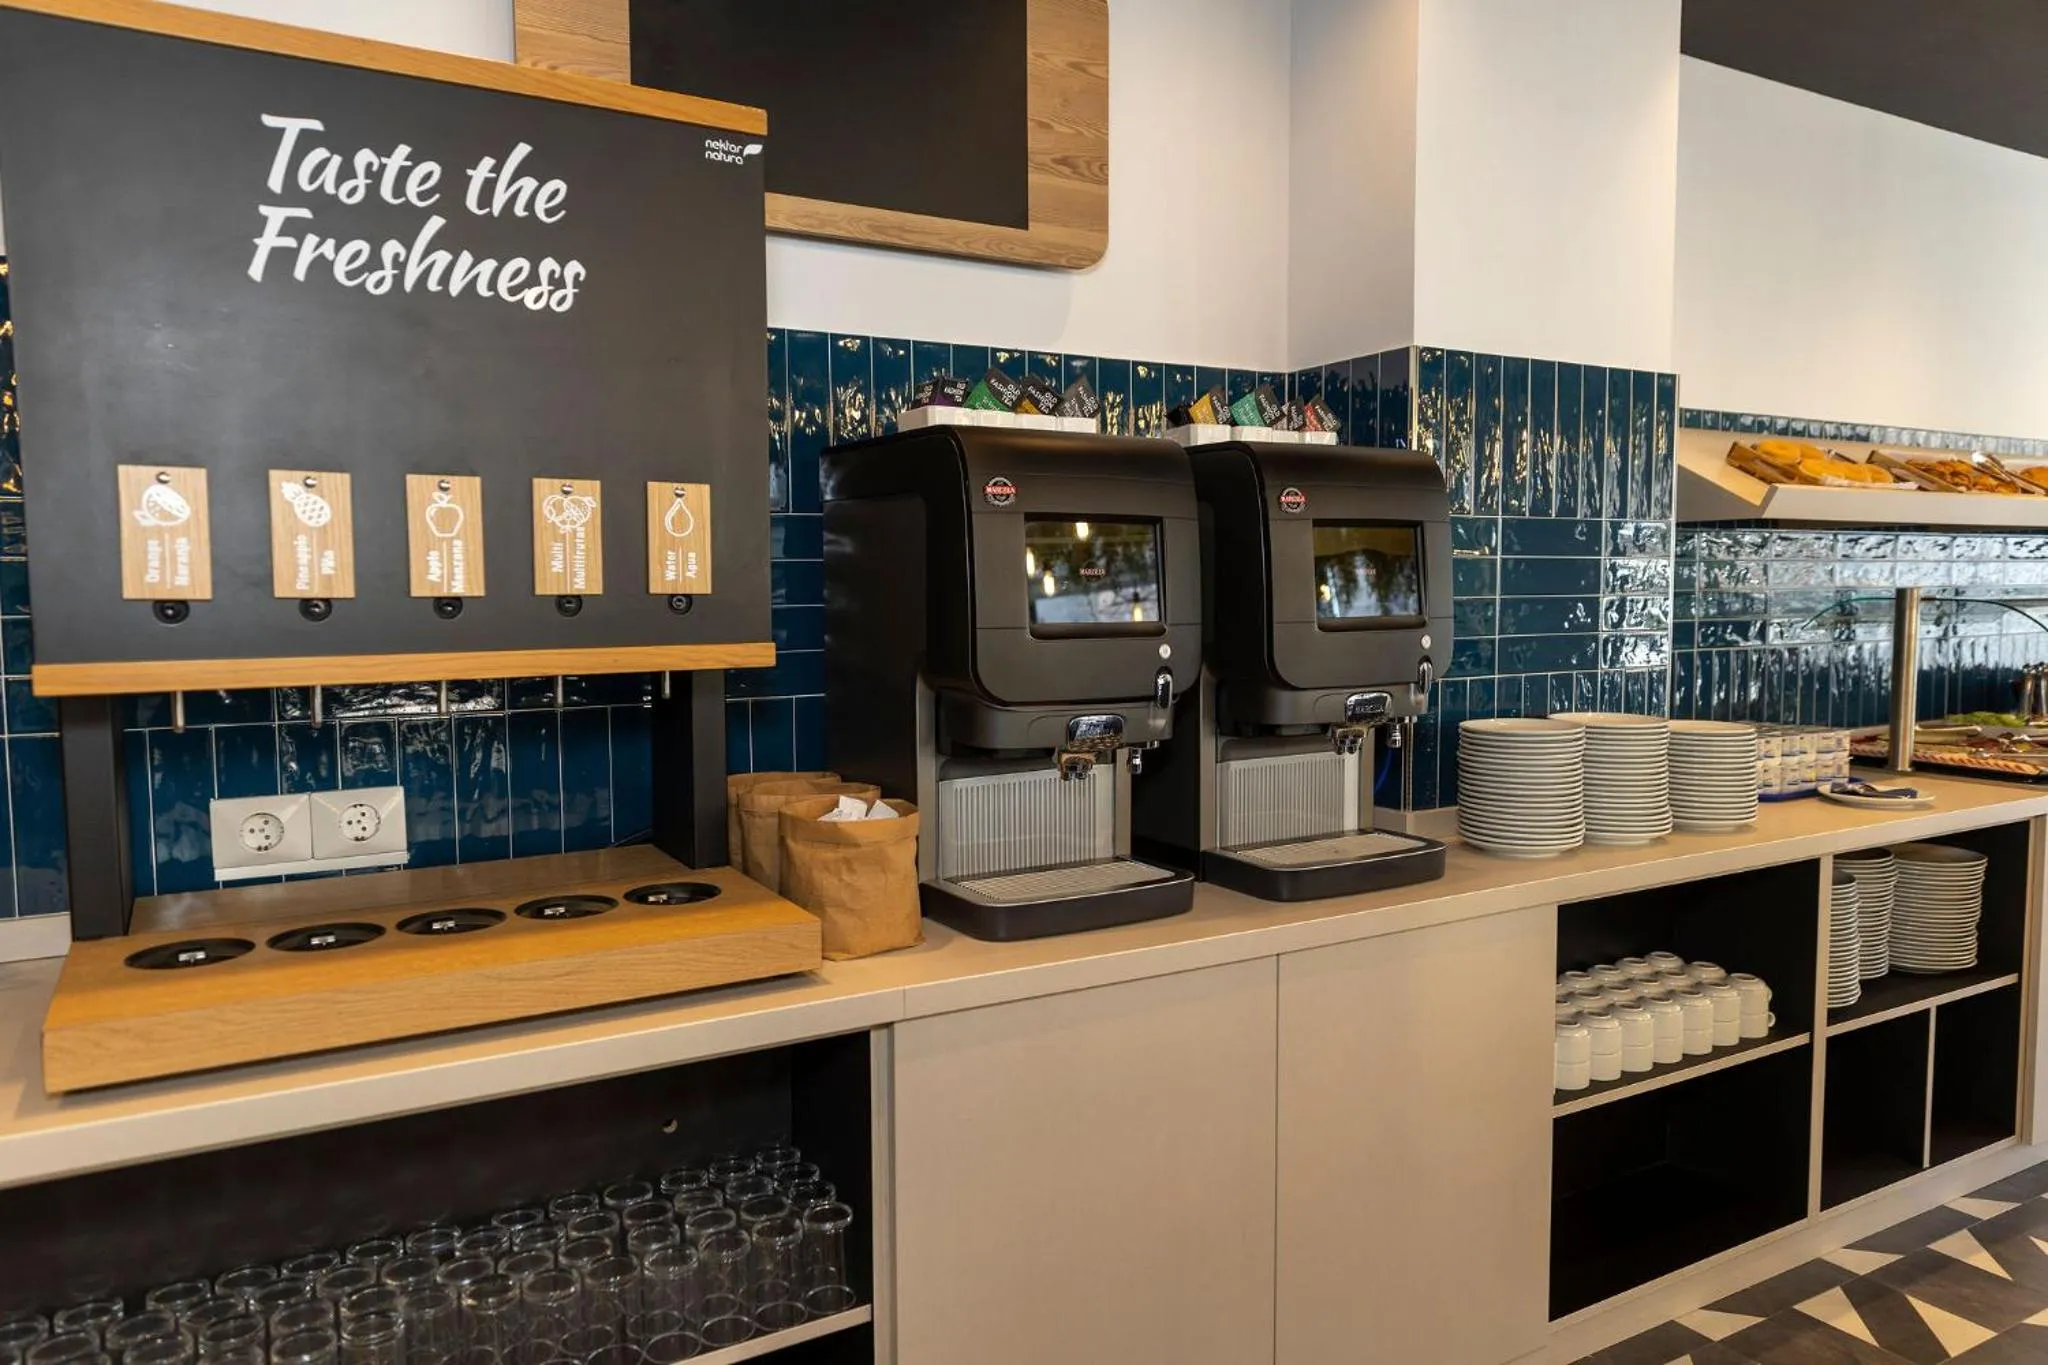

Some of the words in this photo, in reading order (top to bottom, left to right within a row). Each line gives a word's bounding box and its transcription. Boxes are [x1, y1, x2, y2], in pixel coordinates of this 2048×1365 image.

[705, 139, 743, 153] nektar
[705, 150, 744, 165] natura
[261, 113, 442, 207] Taste
[465, 142, 568, 223] the
[247, 204, 586, 313] Freshness
[1007, 384, 1021, 397] OLD
[1044, 391, 1058, 404] OLD
[144, 539, 163, 583] Orange
[174, 536, 191, 586] Naranja
[426, 549, 443, 582] Apple
[450, 539, 465, 594] Manzana
[550, 541, 565, 574] Multi
[664, 550, 677, 581] Water
[685, 551, 698, 579] Agua
